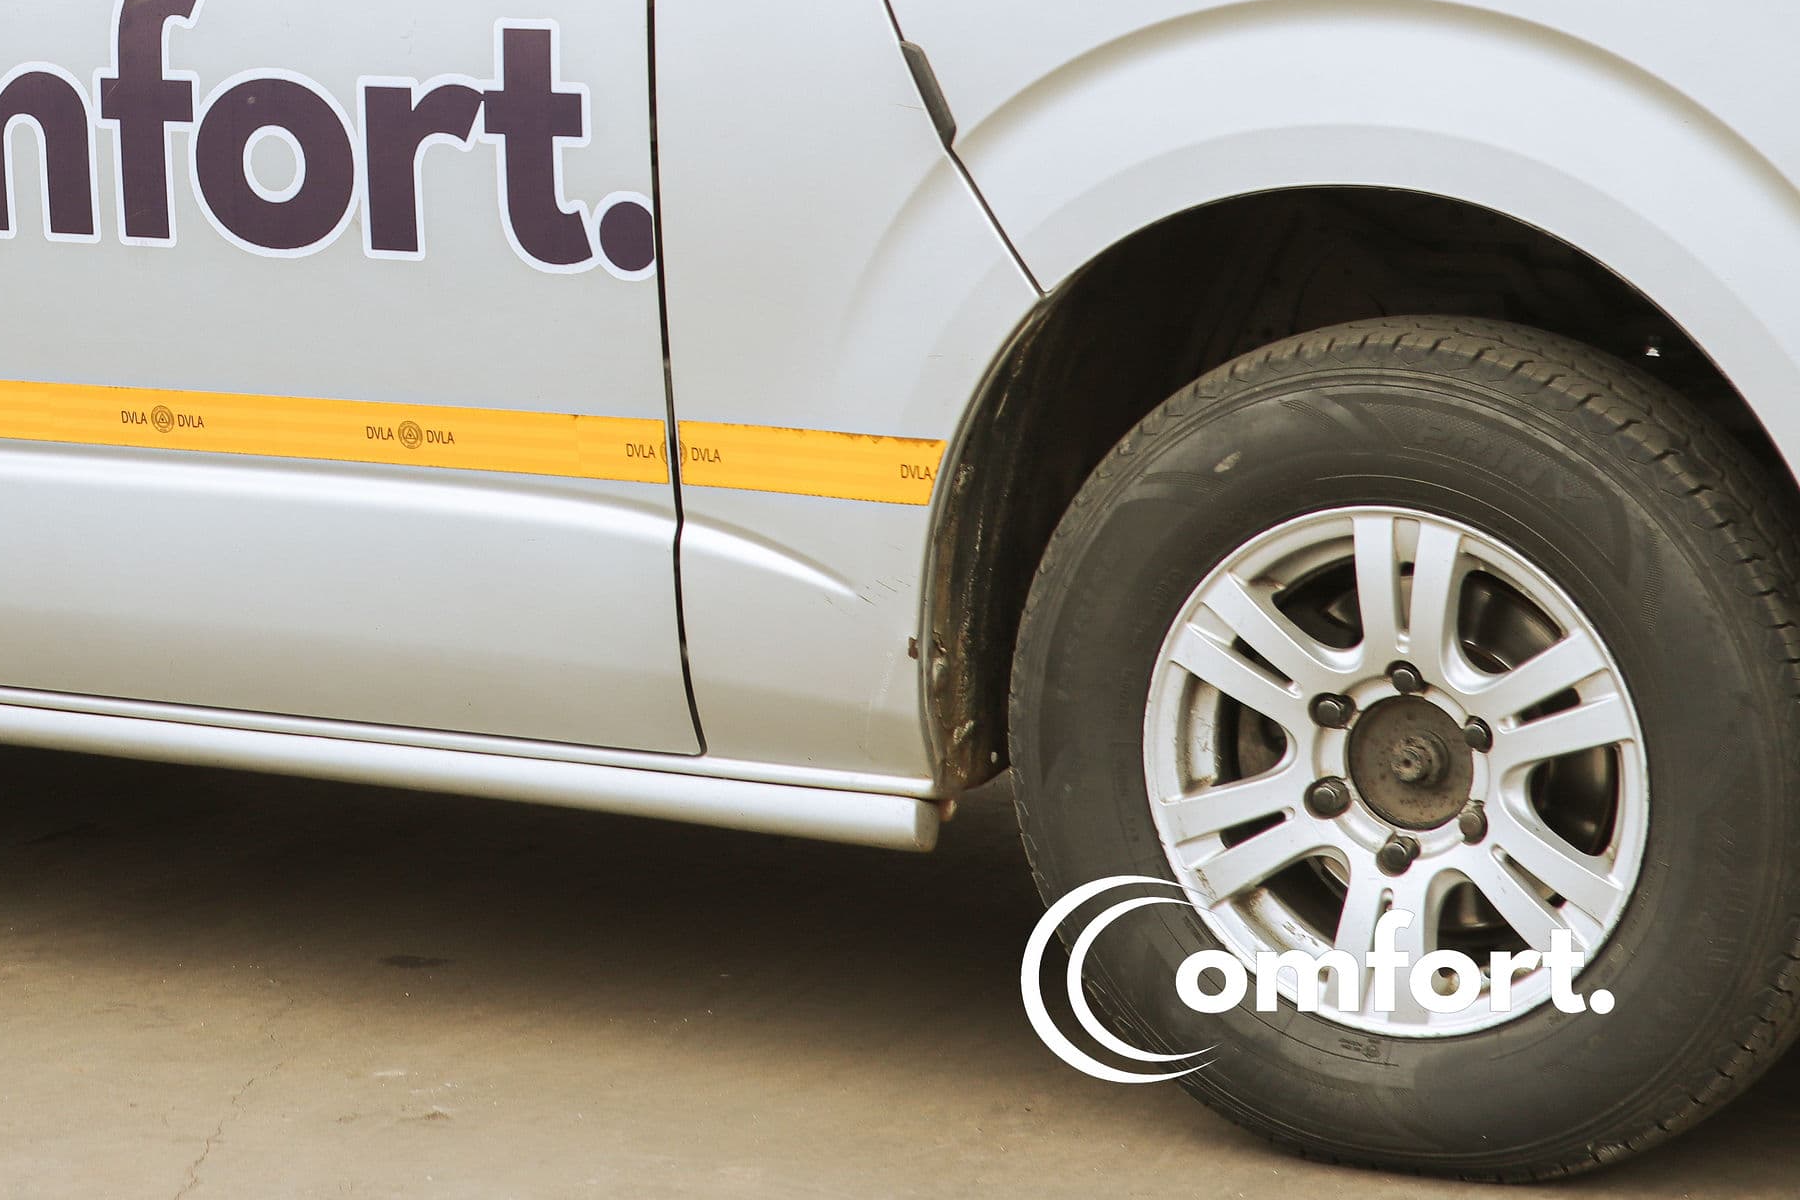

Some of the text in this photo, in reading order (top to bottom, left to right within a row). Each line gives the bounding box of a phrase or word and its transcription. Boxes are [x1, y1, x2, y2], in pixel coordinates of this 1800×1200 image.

[120, 410, 148, 425] DVLA
[176, 413, 205, 429] DVLA
[366, 425, 395, 441] DVLA
[426, 429, 456, 445] DVLA
[625, 443, 656, 459] DVLA
[691, 446, 722, 463] DVLA
[899, 463, 933, 481] DVLA
